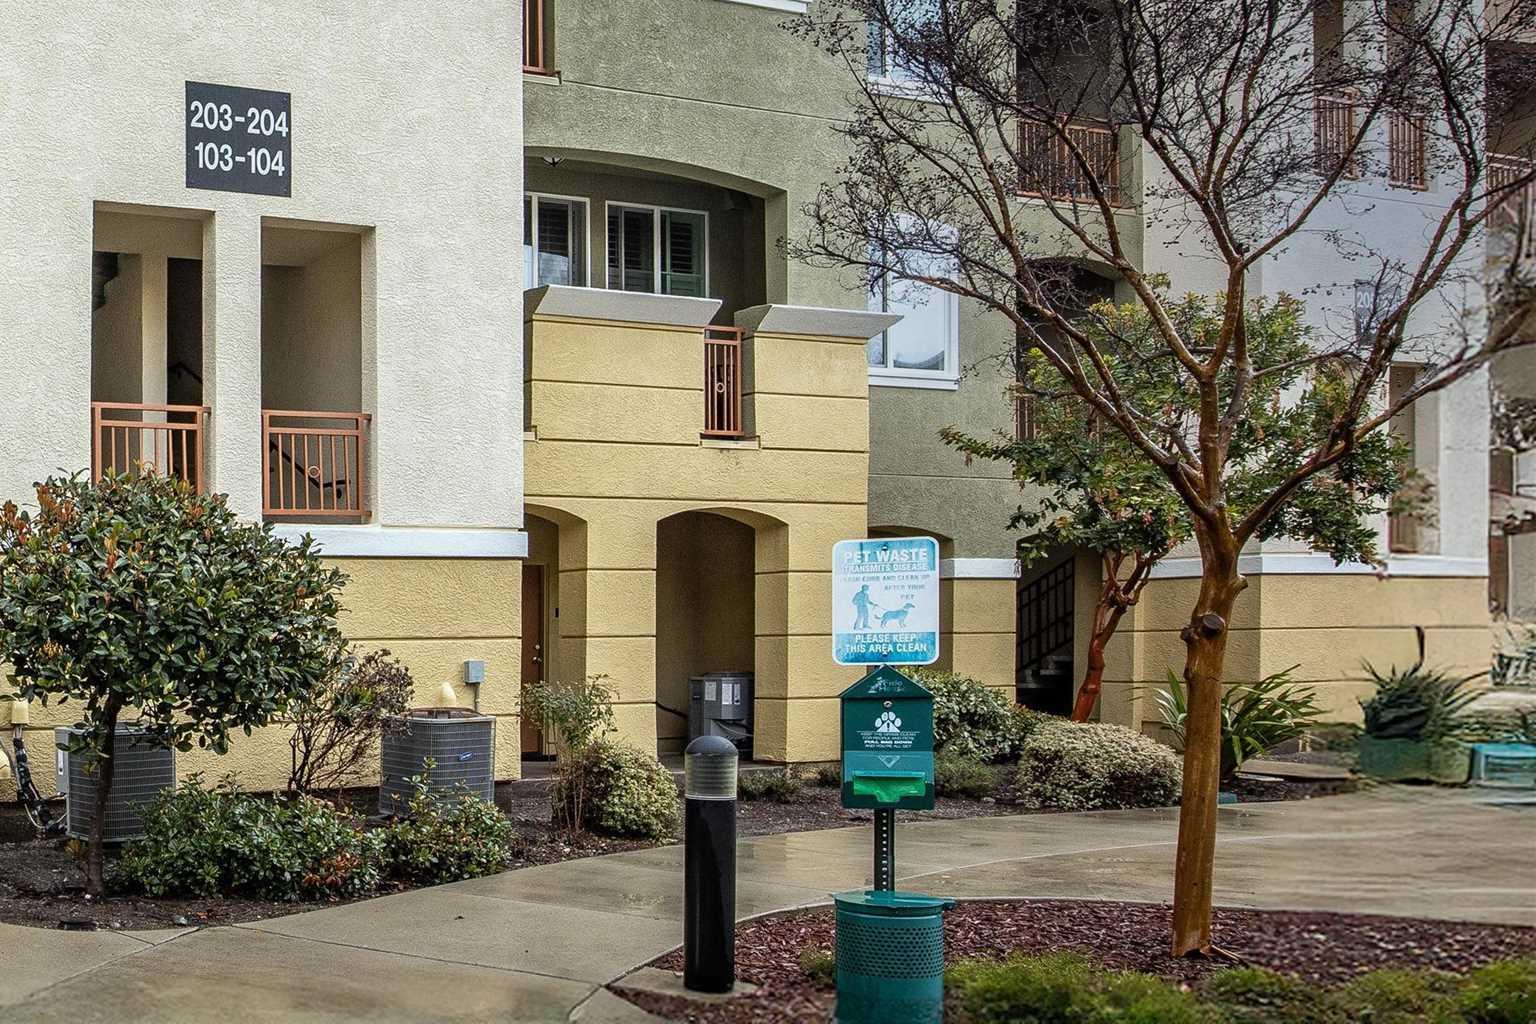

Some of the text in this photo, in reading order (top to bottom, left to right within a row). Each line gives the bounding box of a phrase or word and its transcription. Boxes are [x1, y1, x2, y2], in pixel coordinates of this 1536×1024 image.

[190, 101, 289, 137] 203-204
[195, 142, 285, 176] 103-104
[844, 548, 927, 562] PET WASTE
[844, 563, 929, 573] TRANSMITS DISEASE
[855, 634, 916, 643] PLEASE KEEP
[846, 643, 927, 653] THIS AREA CLEAN
